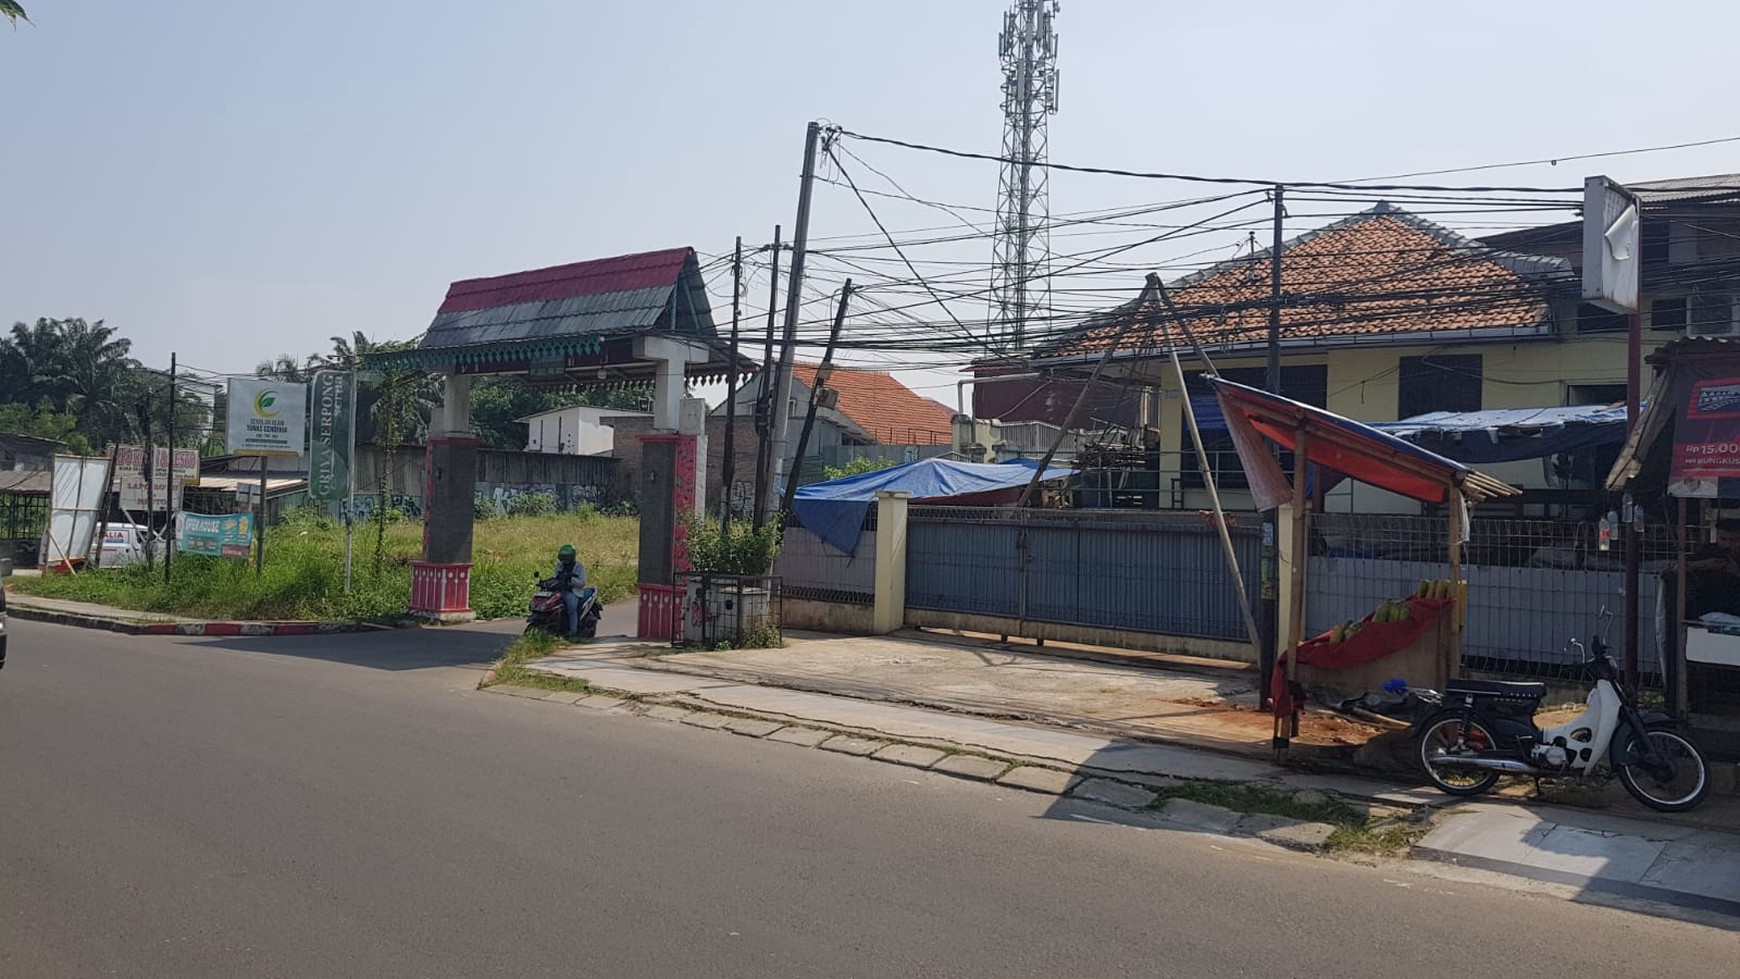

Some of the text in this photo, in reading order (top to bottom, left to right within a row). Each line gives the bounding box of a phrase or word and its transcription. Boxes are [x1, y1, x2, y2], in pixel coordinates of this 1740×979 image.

[319, 374, 334, 496] GRIYA SERPONG
[1686, 443, 1740, 455] Rp 15.00
